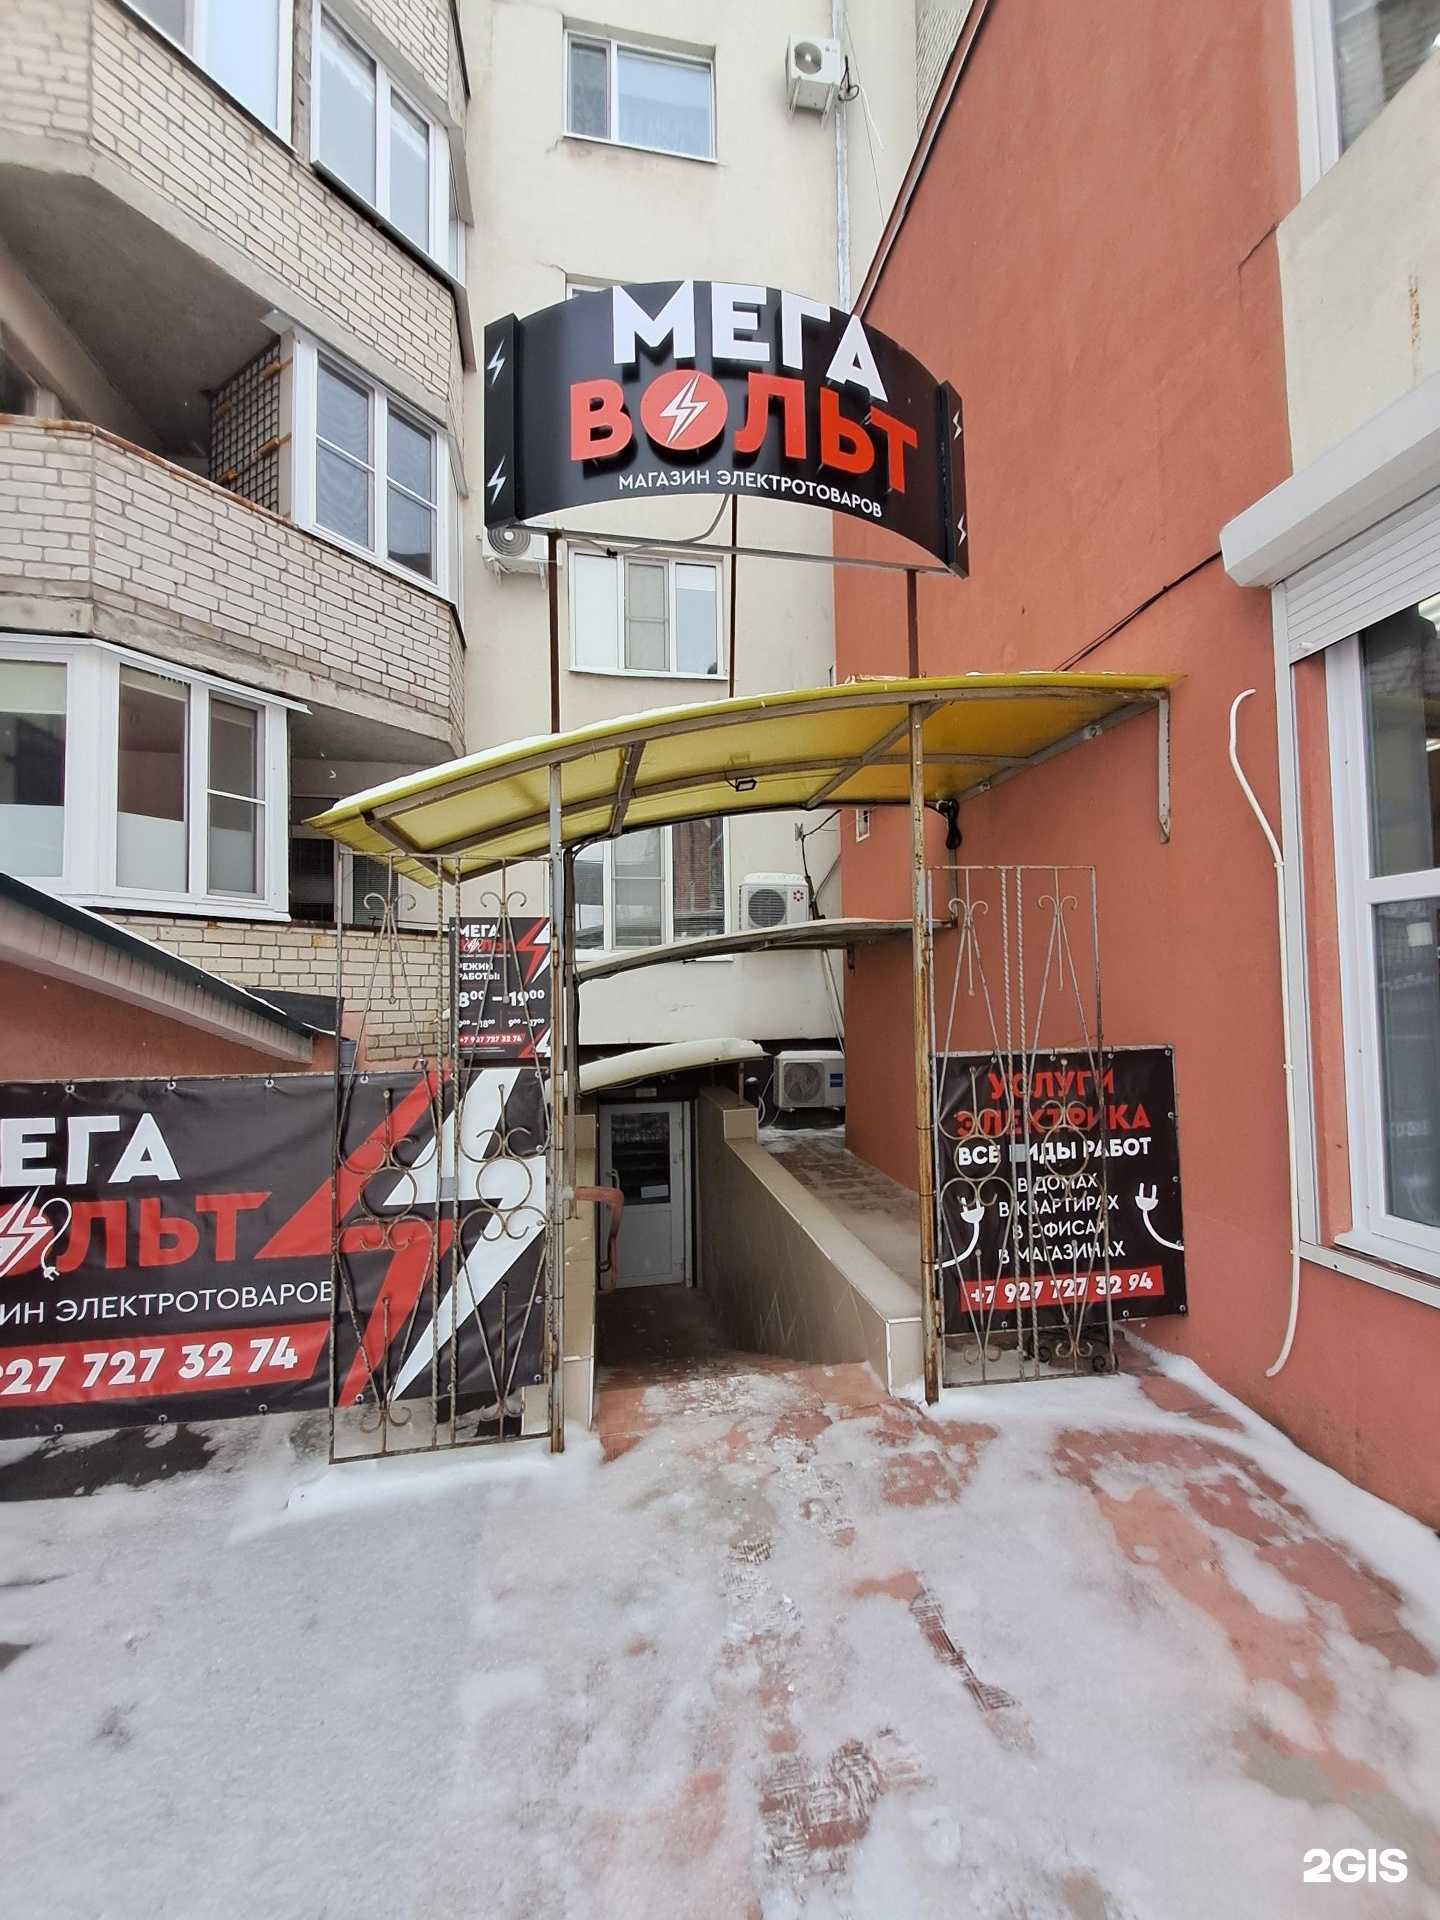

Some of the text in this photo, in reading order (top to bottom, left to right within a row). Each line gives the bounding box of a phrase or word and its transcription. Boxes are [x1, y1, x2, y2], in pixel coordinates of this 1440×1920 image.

[612, 280, 888, 402] МЕГА
[569, 369, 918, 494] ВОЛЬТ
[618, 470, 882, 518] МАГАЗИН ЭЛЕКТРОТОВАРОВ
[958, 1136, 1152, 1167] ВСЕ ИДЫ РАБОТ
[1017, 1177, 1028, 1193] В
[998, 1201, 1010, 1218] В
[998, 1248, 1010, 1265] В
[55, 1280, 333, 1322] ЭЛЕКТРОТОВАРОВ
[970, 1271, 1154, 1304] +7 927 727 32 94
[0, 1335, 299, 1395] 27 727 32 74
